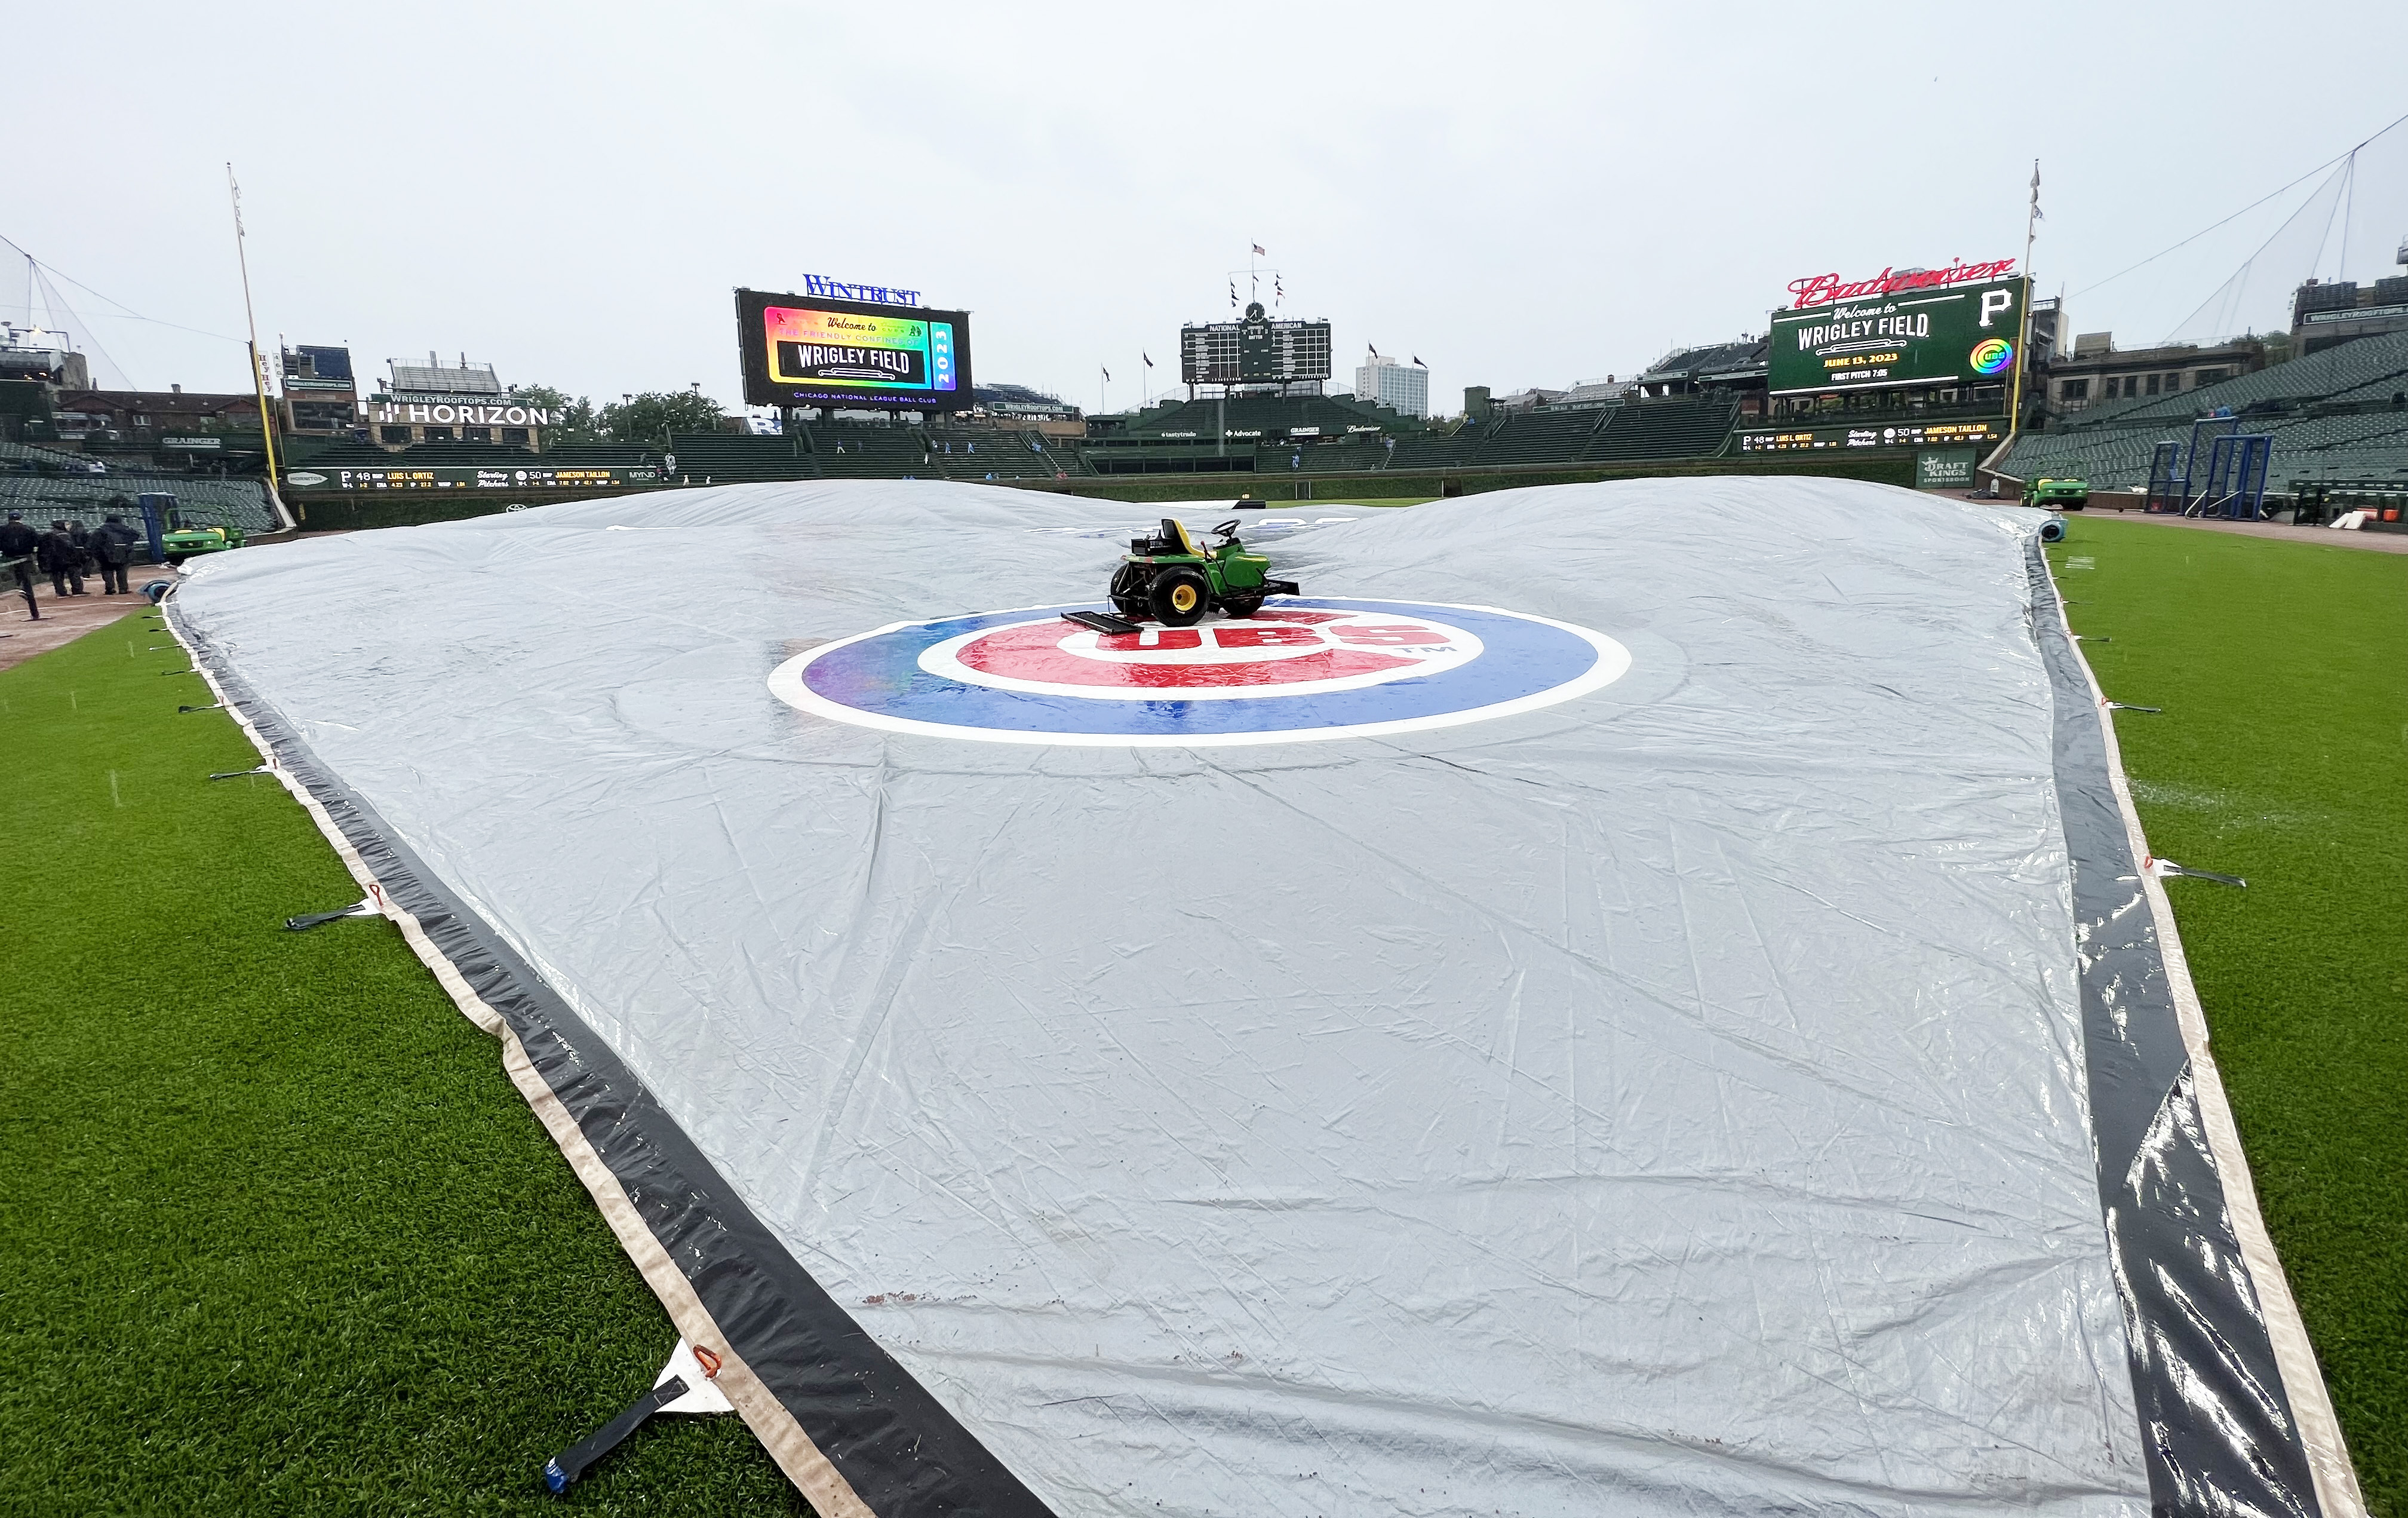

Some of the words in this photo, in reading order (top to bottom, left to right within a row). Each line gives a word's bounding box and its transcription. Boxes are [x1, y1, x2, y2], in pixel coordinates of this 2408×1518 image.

[803, 274, 920, 306] WINTRUST
[1787, 258, 2016, 308] Budweiser
[1833, 304, 1884, 320] Welcome
[1884, 302, 1897, 314] to
[1979, 289, 2012, 327] P
[827, 317, 867, 330] Welcome
[868, 323, 876, 331] to
[803, 330, 851, 339] FRIENDLY
[856, 335, 903, 345] CONFINES
[1798, 320, 1876, 350] WRIGLEY
[798, 345, 865, 369] WRIGLEY
[870, 350, 909, 374] FIELD
[936, 330, 950, 384] 2023
[1823, 357, 1851, 368] JUNE
[1853, 355, 1866, 366] 13,
[1869, 353, 1898, 363] 2023
[1831, 370, 1850, 381] FIRST
[1850, 369, 1871, 380] PITCH
[1872, 368, 1888, 378] 7:05
[408, 404, 548, 425] HORIZON
[1347, 425, 1381, 433] Budweiser
[1848, 430, 1877, 438] Starting
[1924, 426, 1957, 434] JAMESON
[1959, 424, 1987, 433] TAILLON
[1847, 438, 1876, 447] Pitchers
[1924, 462, 1968, 472] DRAFT
[341, 471, 351, 482] P
[357, 472, 370, 480] 48
[477, 471, 508, 480] Starting
